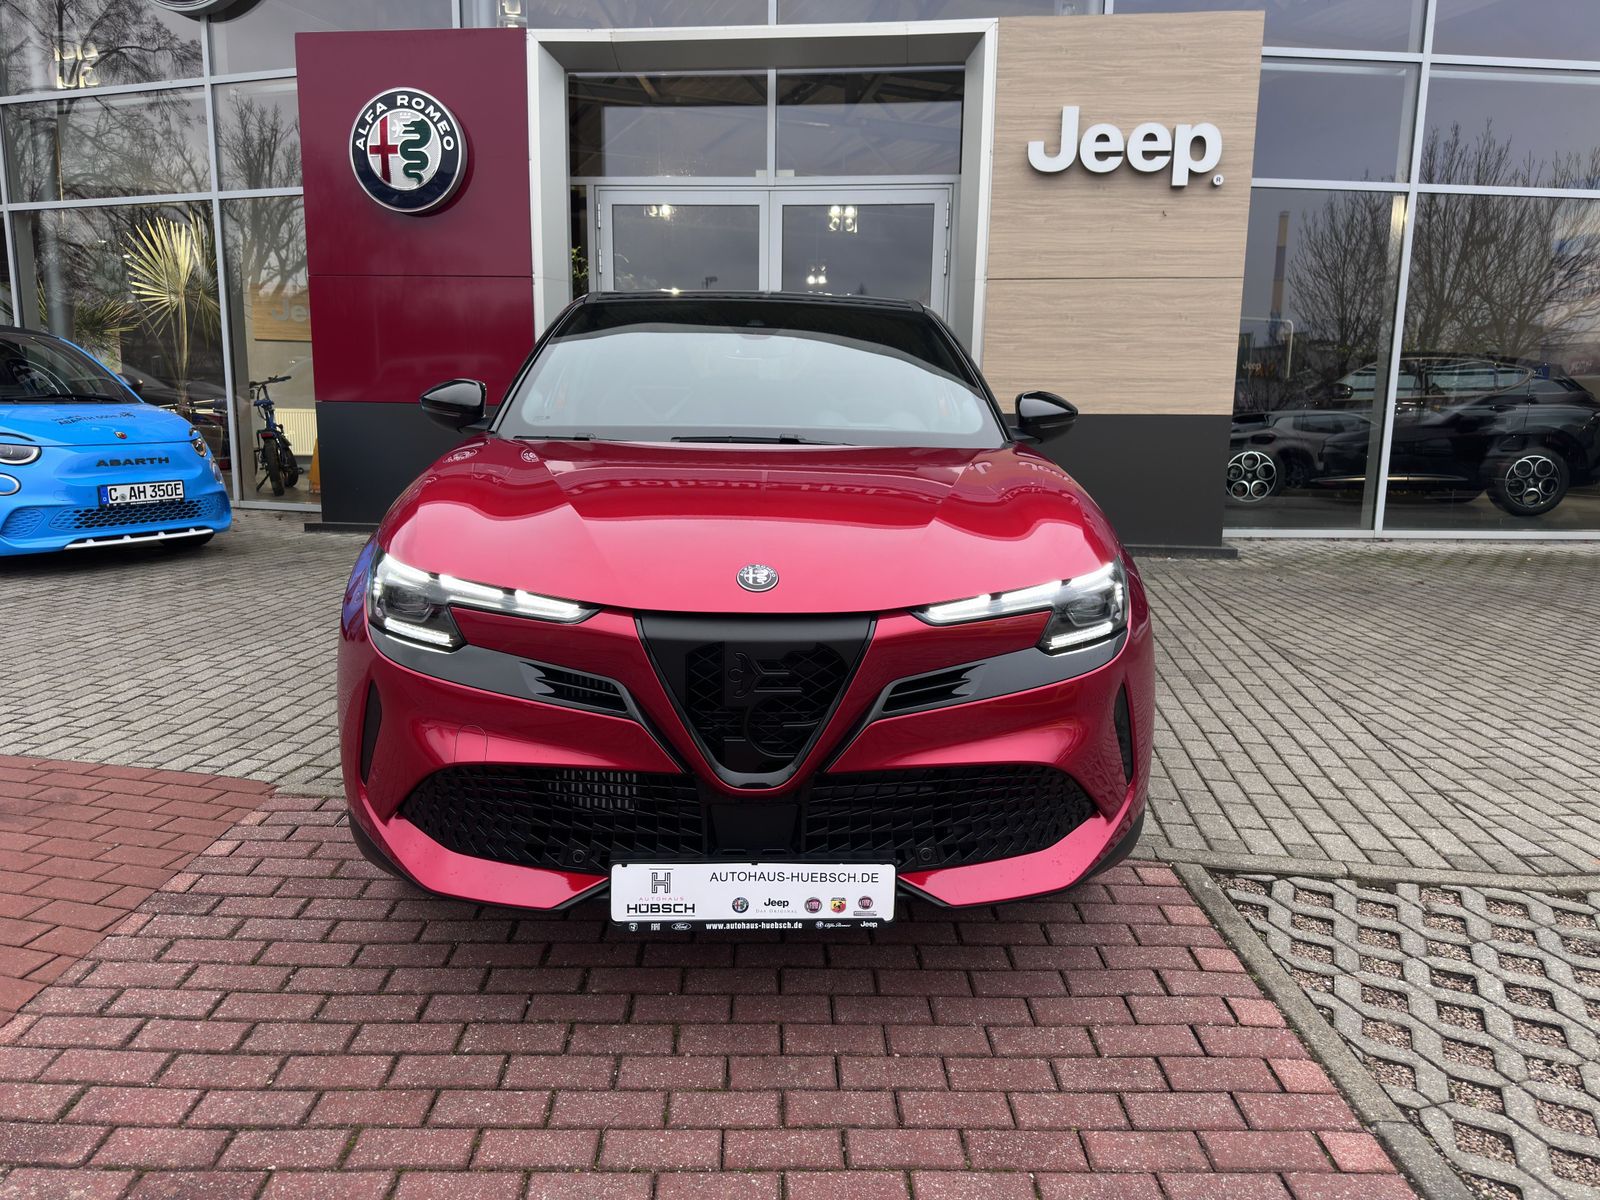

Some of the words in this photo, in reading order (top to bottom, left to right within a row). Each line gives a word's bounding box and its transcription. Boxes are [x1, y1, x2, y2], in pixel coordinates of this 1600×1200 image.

[355, 102, 388, 151] ALFA
[396, 94, 455, 151] ROMEO
[1027, 105, 1223, 187] Jeep
[271, 298, 309, 323] Je
[96, 456, 170, 467] ABARTH
[108, 487, 119, 502] C
[129, 485, 147, 501] AH
[149, 482, 183, 499] 350E
[710, 871, 879, 883] AUTOHAUS-HUEBSCH.DE
[763, 897, 790, 908] Jeep
[626, 903, 696, 914] HÜBSCH
[705, 921, 803, 930] www.autohaus-huebsch.de
[860, 920, 878, 928] Jeep
